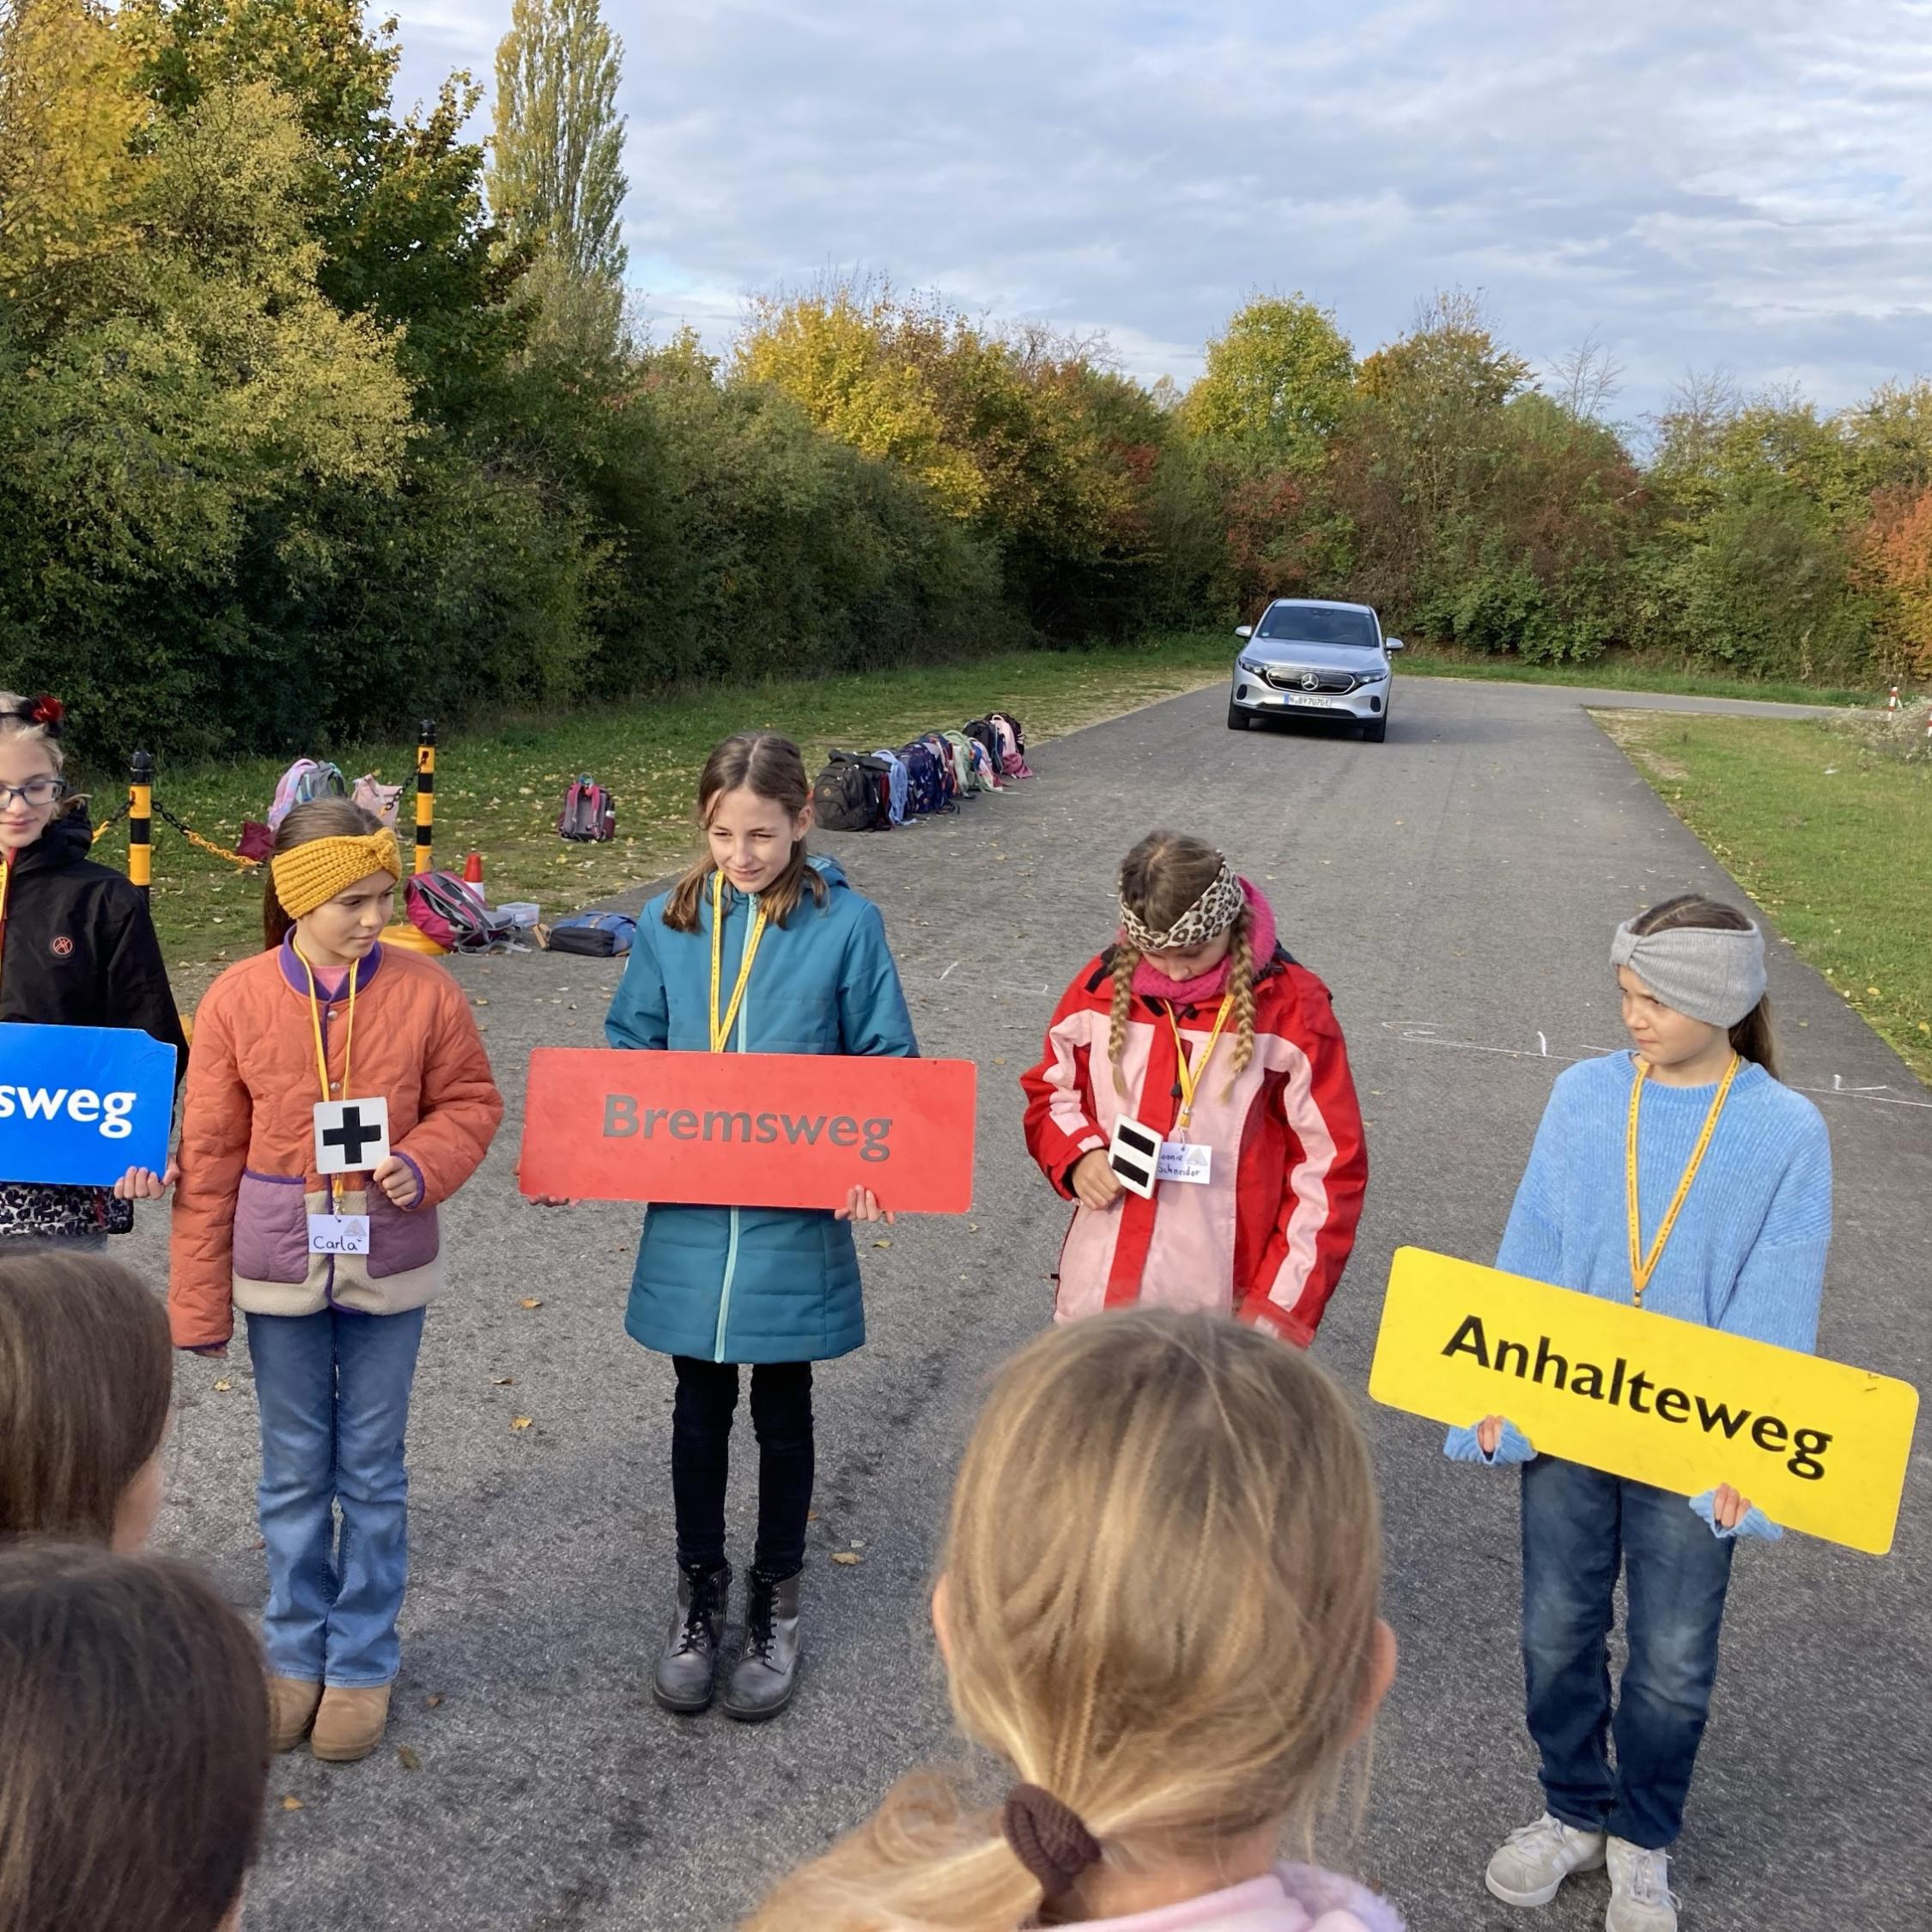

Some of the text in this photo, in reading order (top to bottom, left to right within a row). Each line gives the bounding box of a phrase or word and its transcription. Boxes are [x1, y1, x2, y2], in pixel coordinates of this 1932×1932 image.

[0, 1084, 137, 1139] sweg
[603, 1093, 894, 1163] Bremsweg
[313, 1236, 358, 1251] Carla
[1440, 1314, 1834, 1480] Anhalteweg
